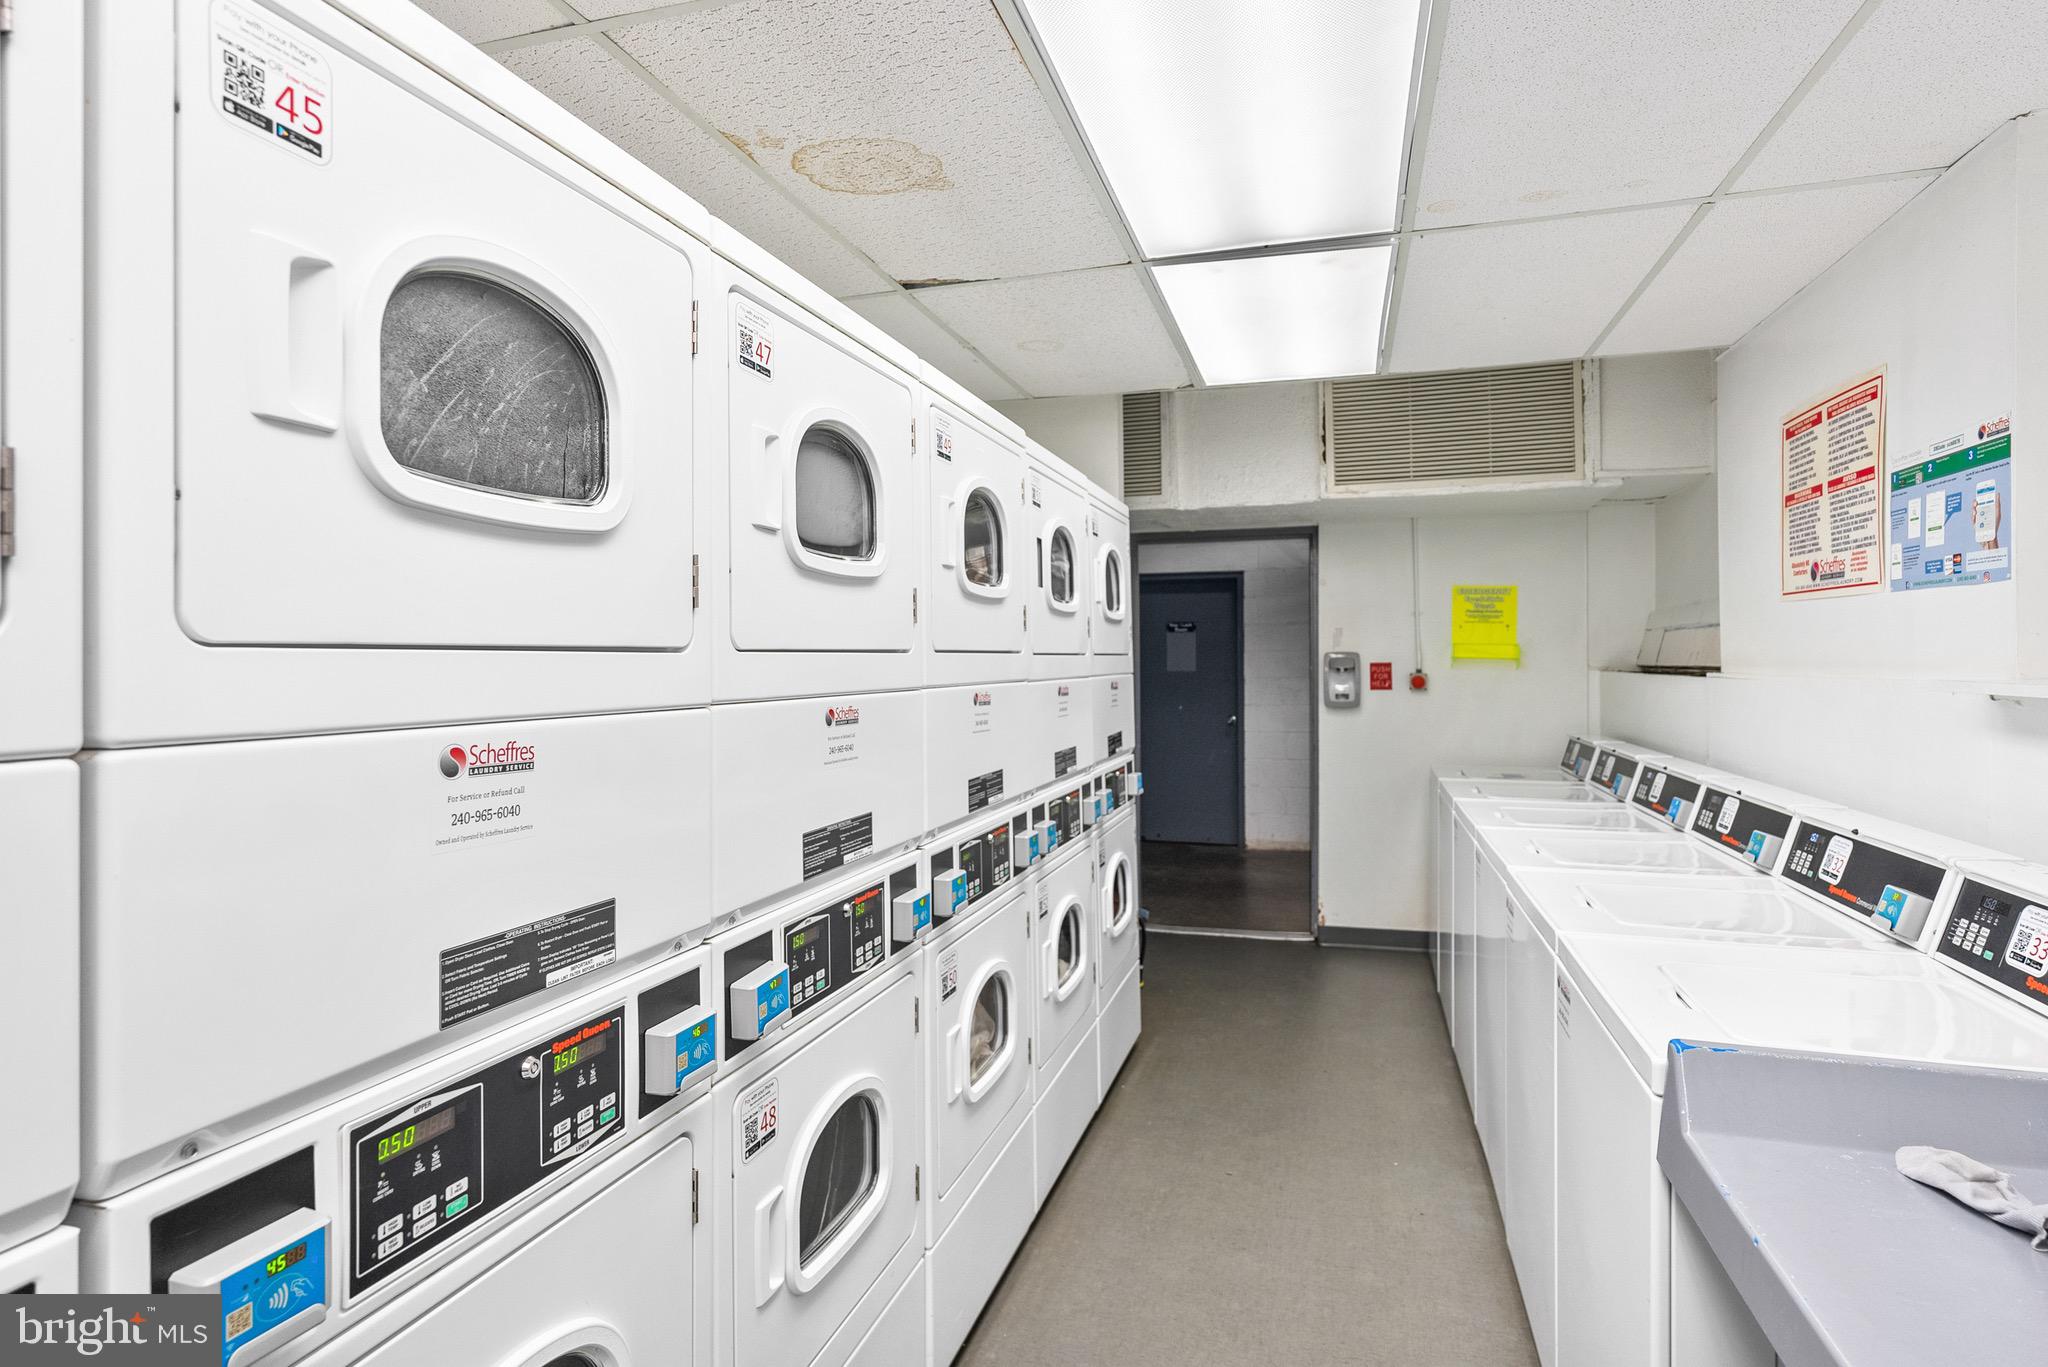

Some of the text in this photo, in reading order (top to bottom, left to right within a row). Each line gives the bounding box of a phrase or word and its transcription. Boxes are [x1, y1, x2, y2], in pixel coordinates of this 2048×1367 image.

[275, 86, 323, 135] 45
[755, 341, 773, 366] 47
[1968, 450, 1974, 460] 3
[1927, 463, 1933, 473] 2
[1820, 556, 1846, 575] Scheffres
[1371, 665, 1391, 673] PUSH
[1371, 680, 1390, 688] HELP
[469, 741, 535, 766] Scheffres
[469, 762, 535, 776] LAUNDRY SERVICE
[447, 794, 459, 804] For
[460, 791, 483, 802] Service
[491, 786, 512, 798] Refund
[514, 785, 526, 795] Call
[451, 804, 521, 827] 240-965-6040
[1831, 857, 1845, 874] 32
[2029, 937, 2048, 960] 33
[948, 969, 958, 988] 50
[552, 1020, 611, 1055] Speed Queen
[693, 1026, 701, 1037] 46
[413, 1100, 432, 1114] UPPER
[760, 1105, 777, 1132] 48
[576, 1139, 589, 1152] LOWER
[267, 1254, 286, 1276] 45
